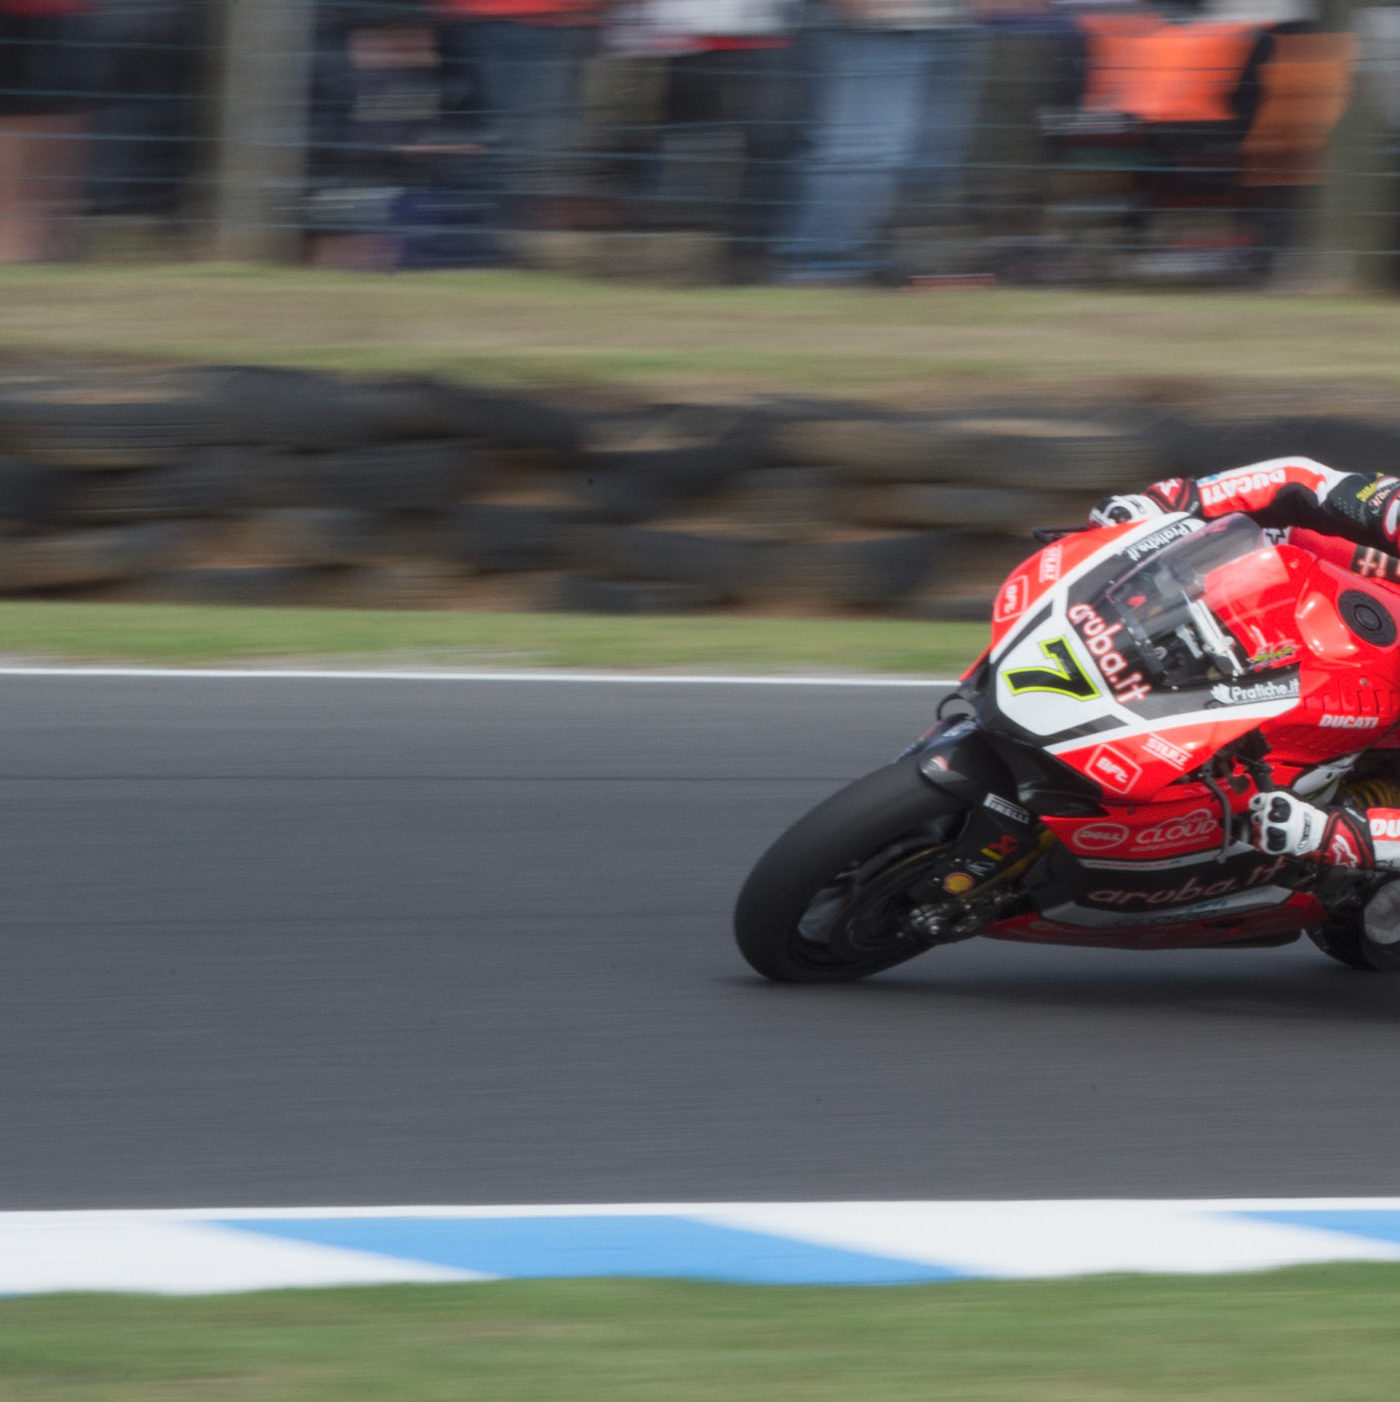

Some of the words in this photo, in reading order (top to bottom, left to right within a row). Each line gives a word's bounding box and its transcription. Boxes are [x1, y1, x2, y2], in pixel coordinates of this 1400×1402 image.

[1202, 469, 1286, 506] DUCATI
[1002, 635, 1102, 702] 7
[1068, 603, 1152, 704] aruba.it
[1231, 678, 1299, 701] Pratiche.it
[1318, 714, 1379, 728] DUCATI
[1136, 819, 1218, 844] CLOUD
